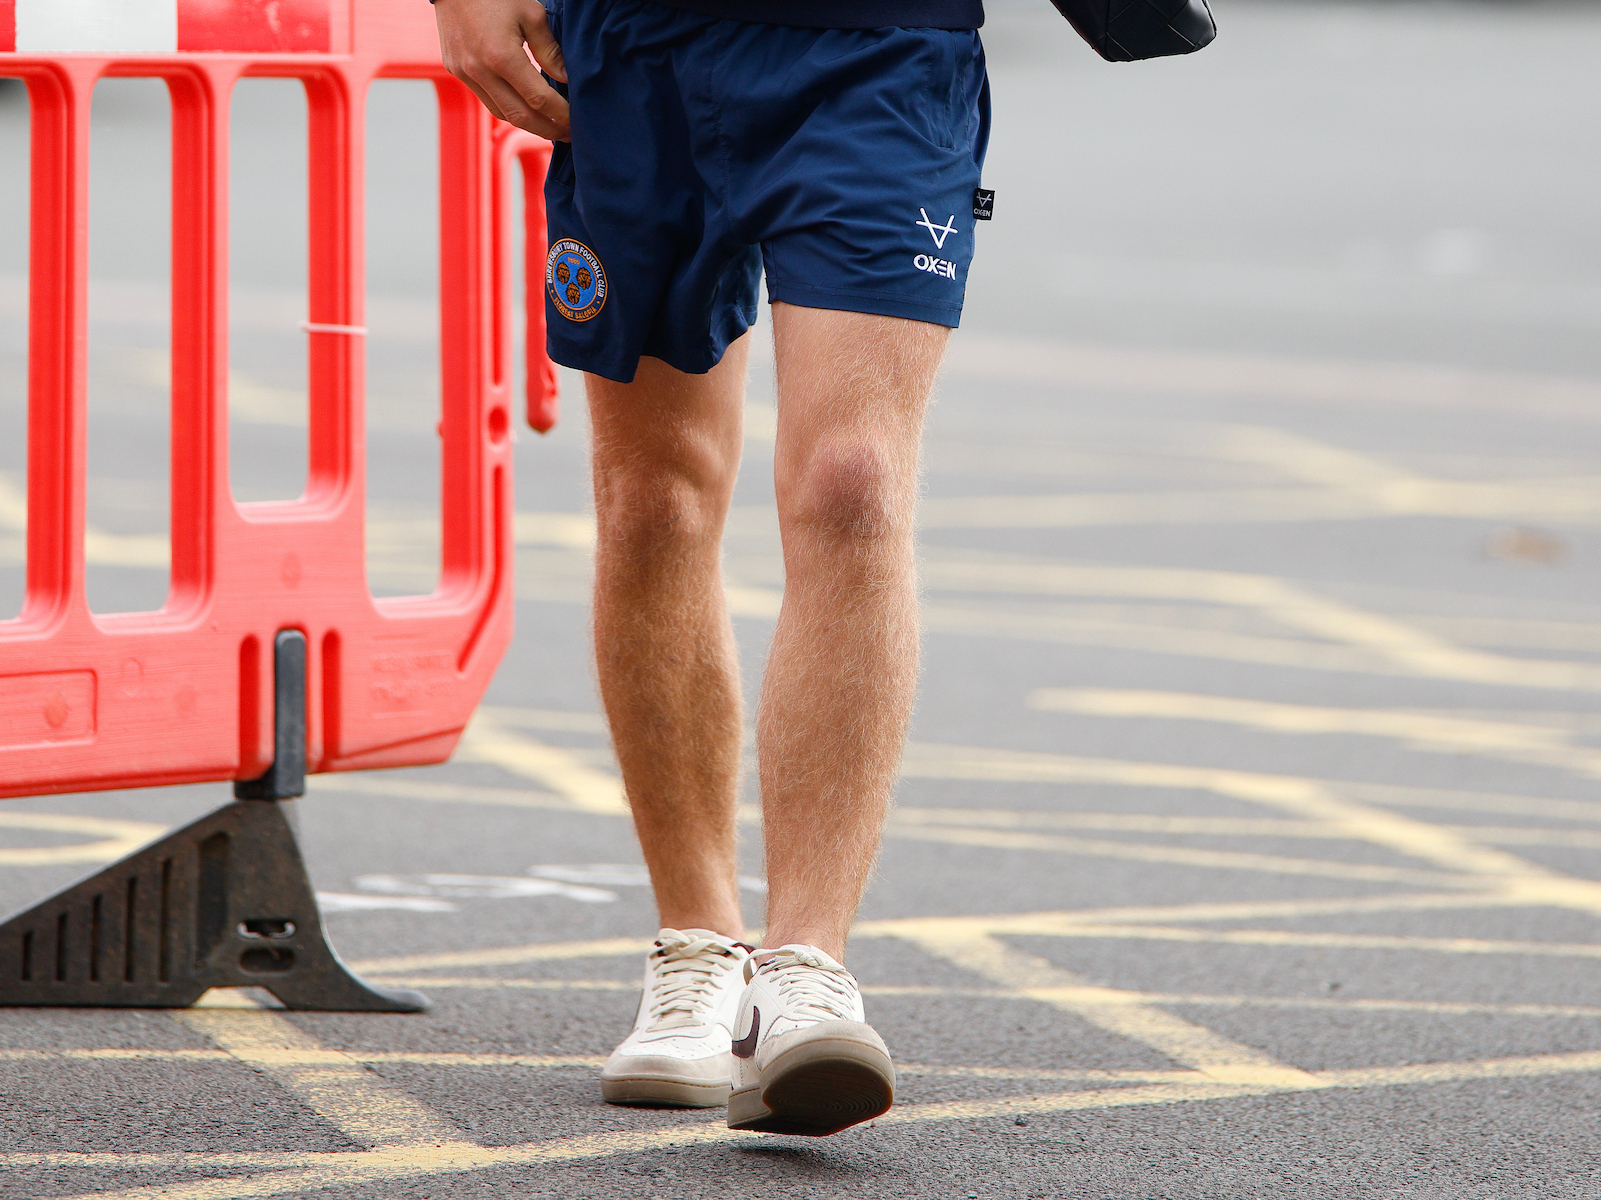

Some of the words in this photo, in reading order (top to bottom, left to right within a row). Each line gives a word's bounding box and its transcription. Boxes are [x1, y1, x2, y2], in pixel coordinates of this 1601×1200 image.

[973, 208, 991, 217] OXEN
[562, 241, 580, 252] TOWN
[579, 246, 602, 279] FOOTBALL
[597, 278, 606, 298] CLUB
[913, 254, 957, 280] OXEN
